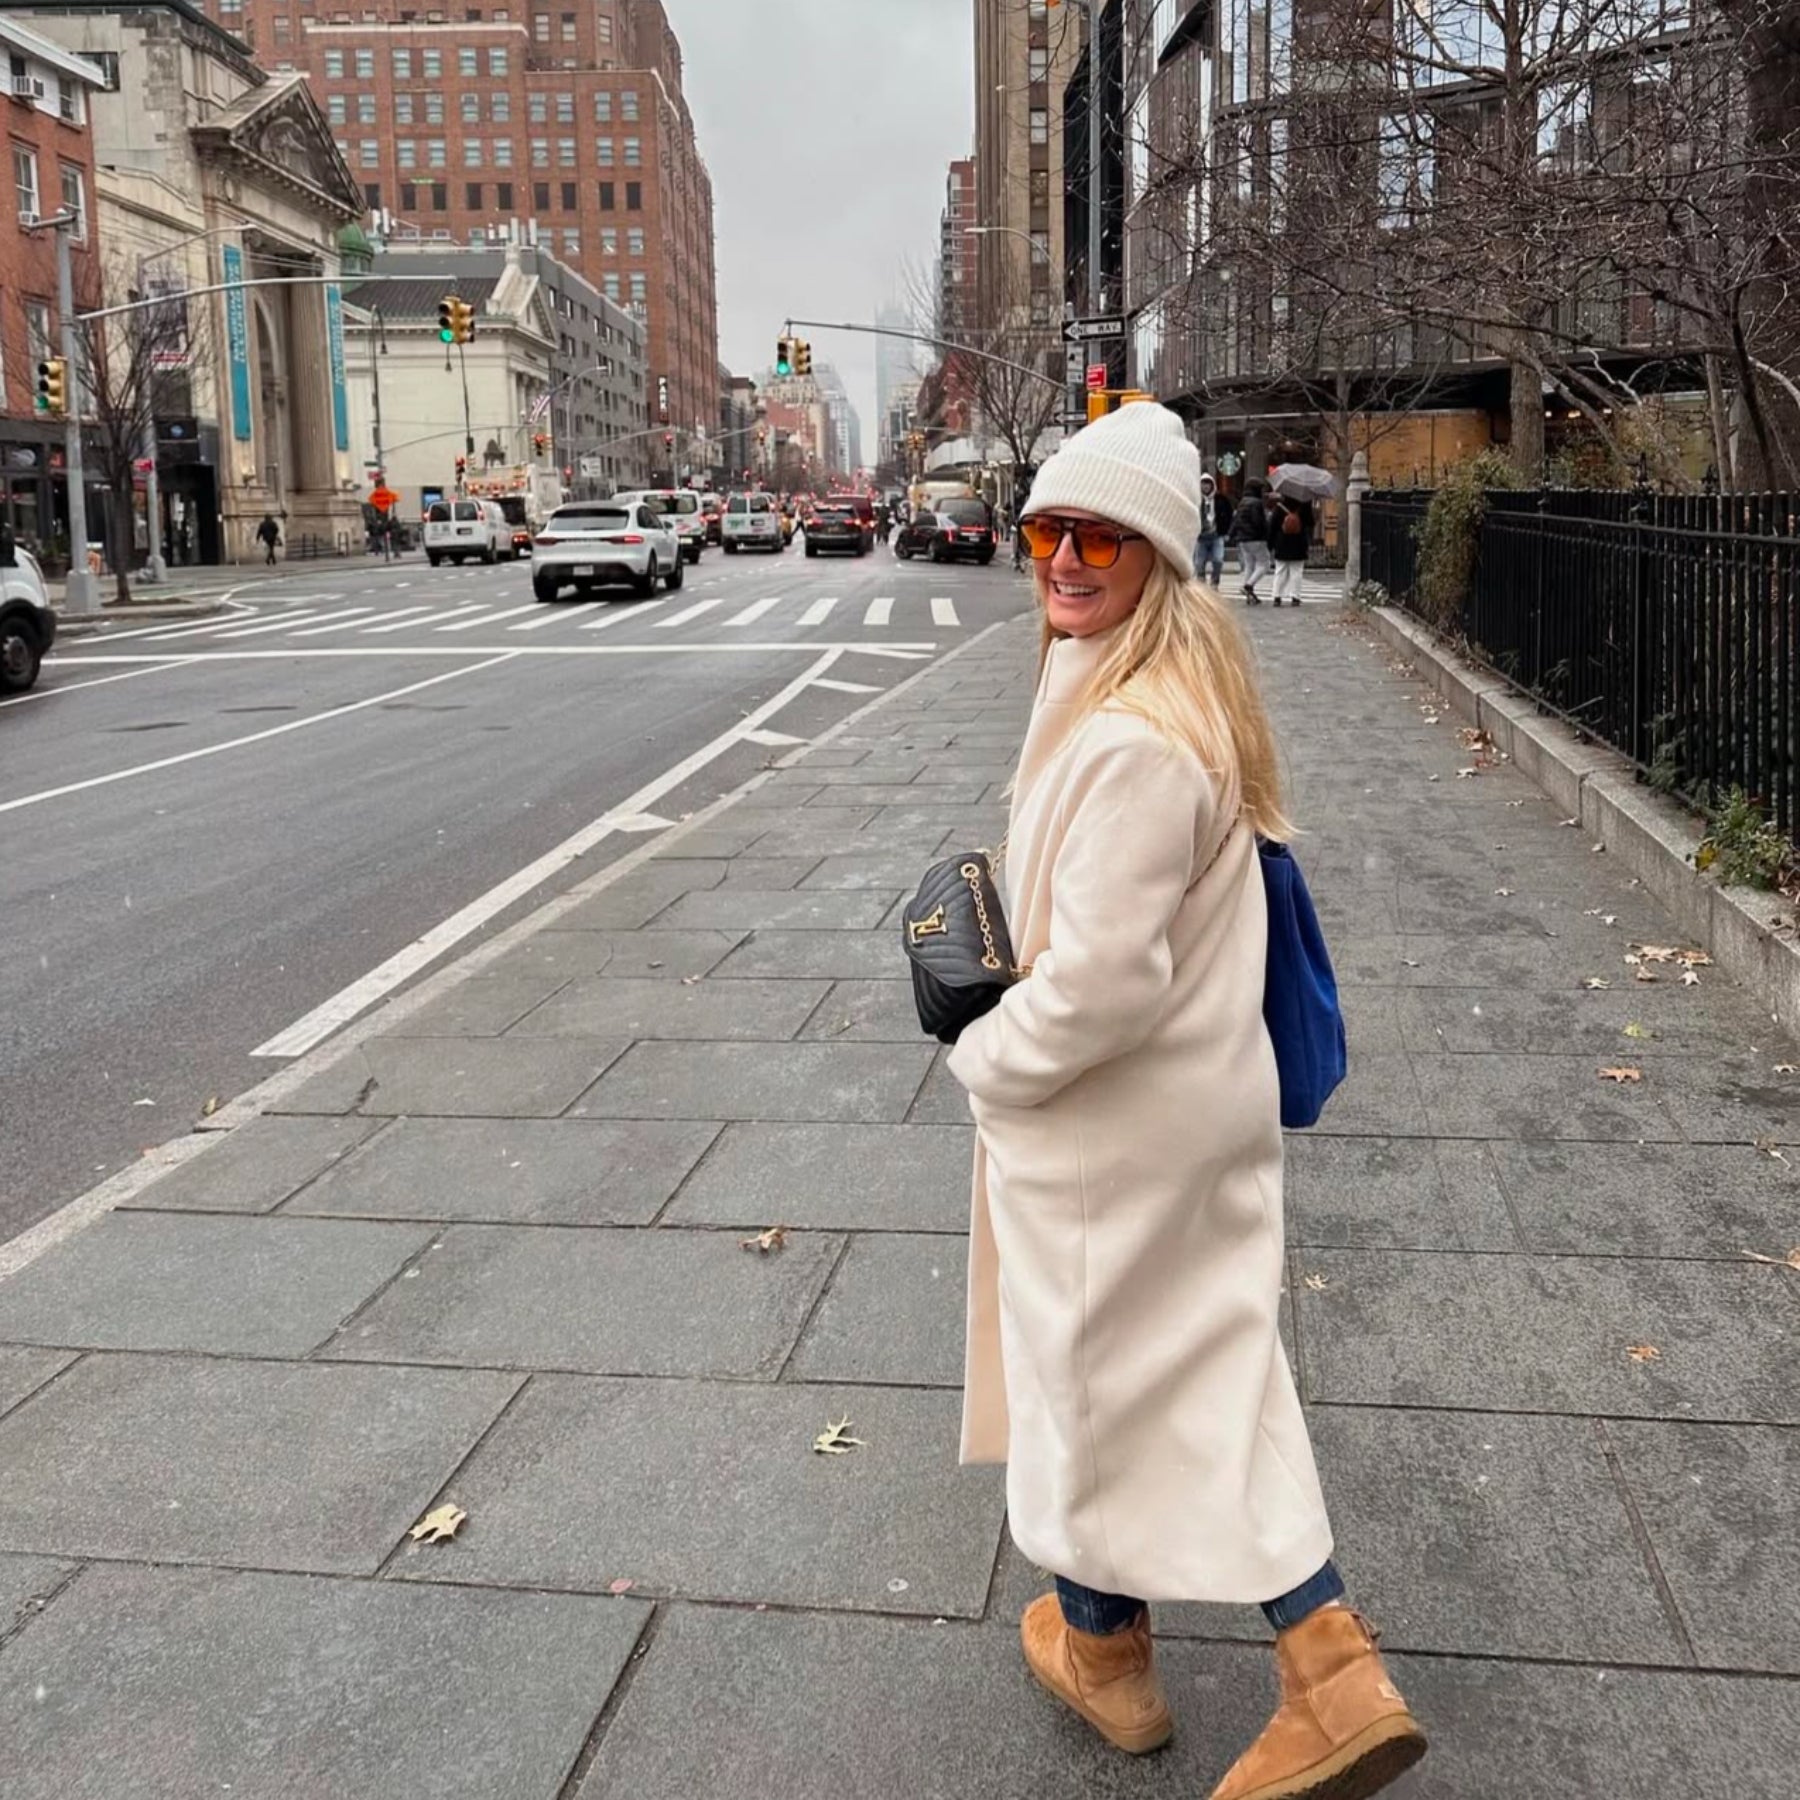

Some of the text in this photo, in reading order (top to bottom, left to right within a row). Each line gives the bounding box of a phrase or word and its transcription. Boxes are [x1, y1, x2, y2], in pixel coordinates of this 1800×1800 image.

[1071, 323, 1117, 336] ONE WAY
[659, 377, 667, 412] PARK
